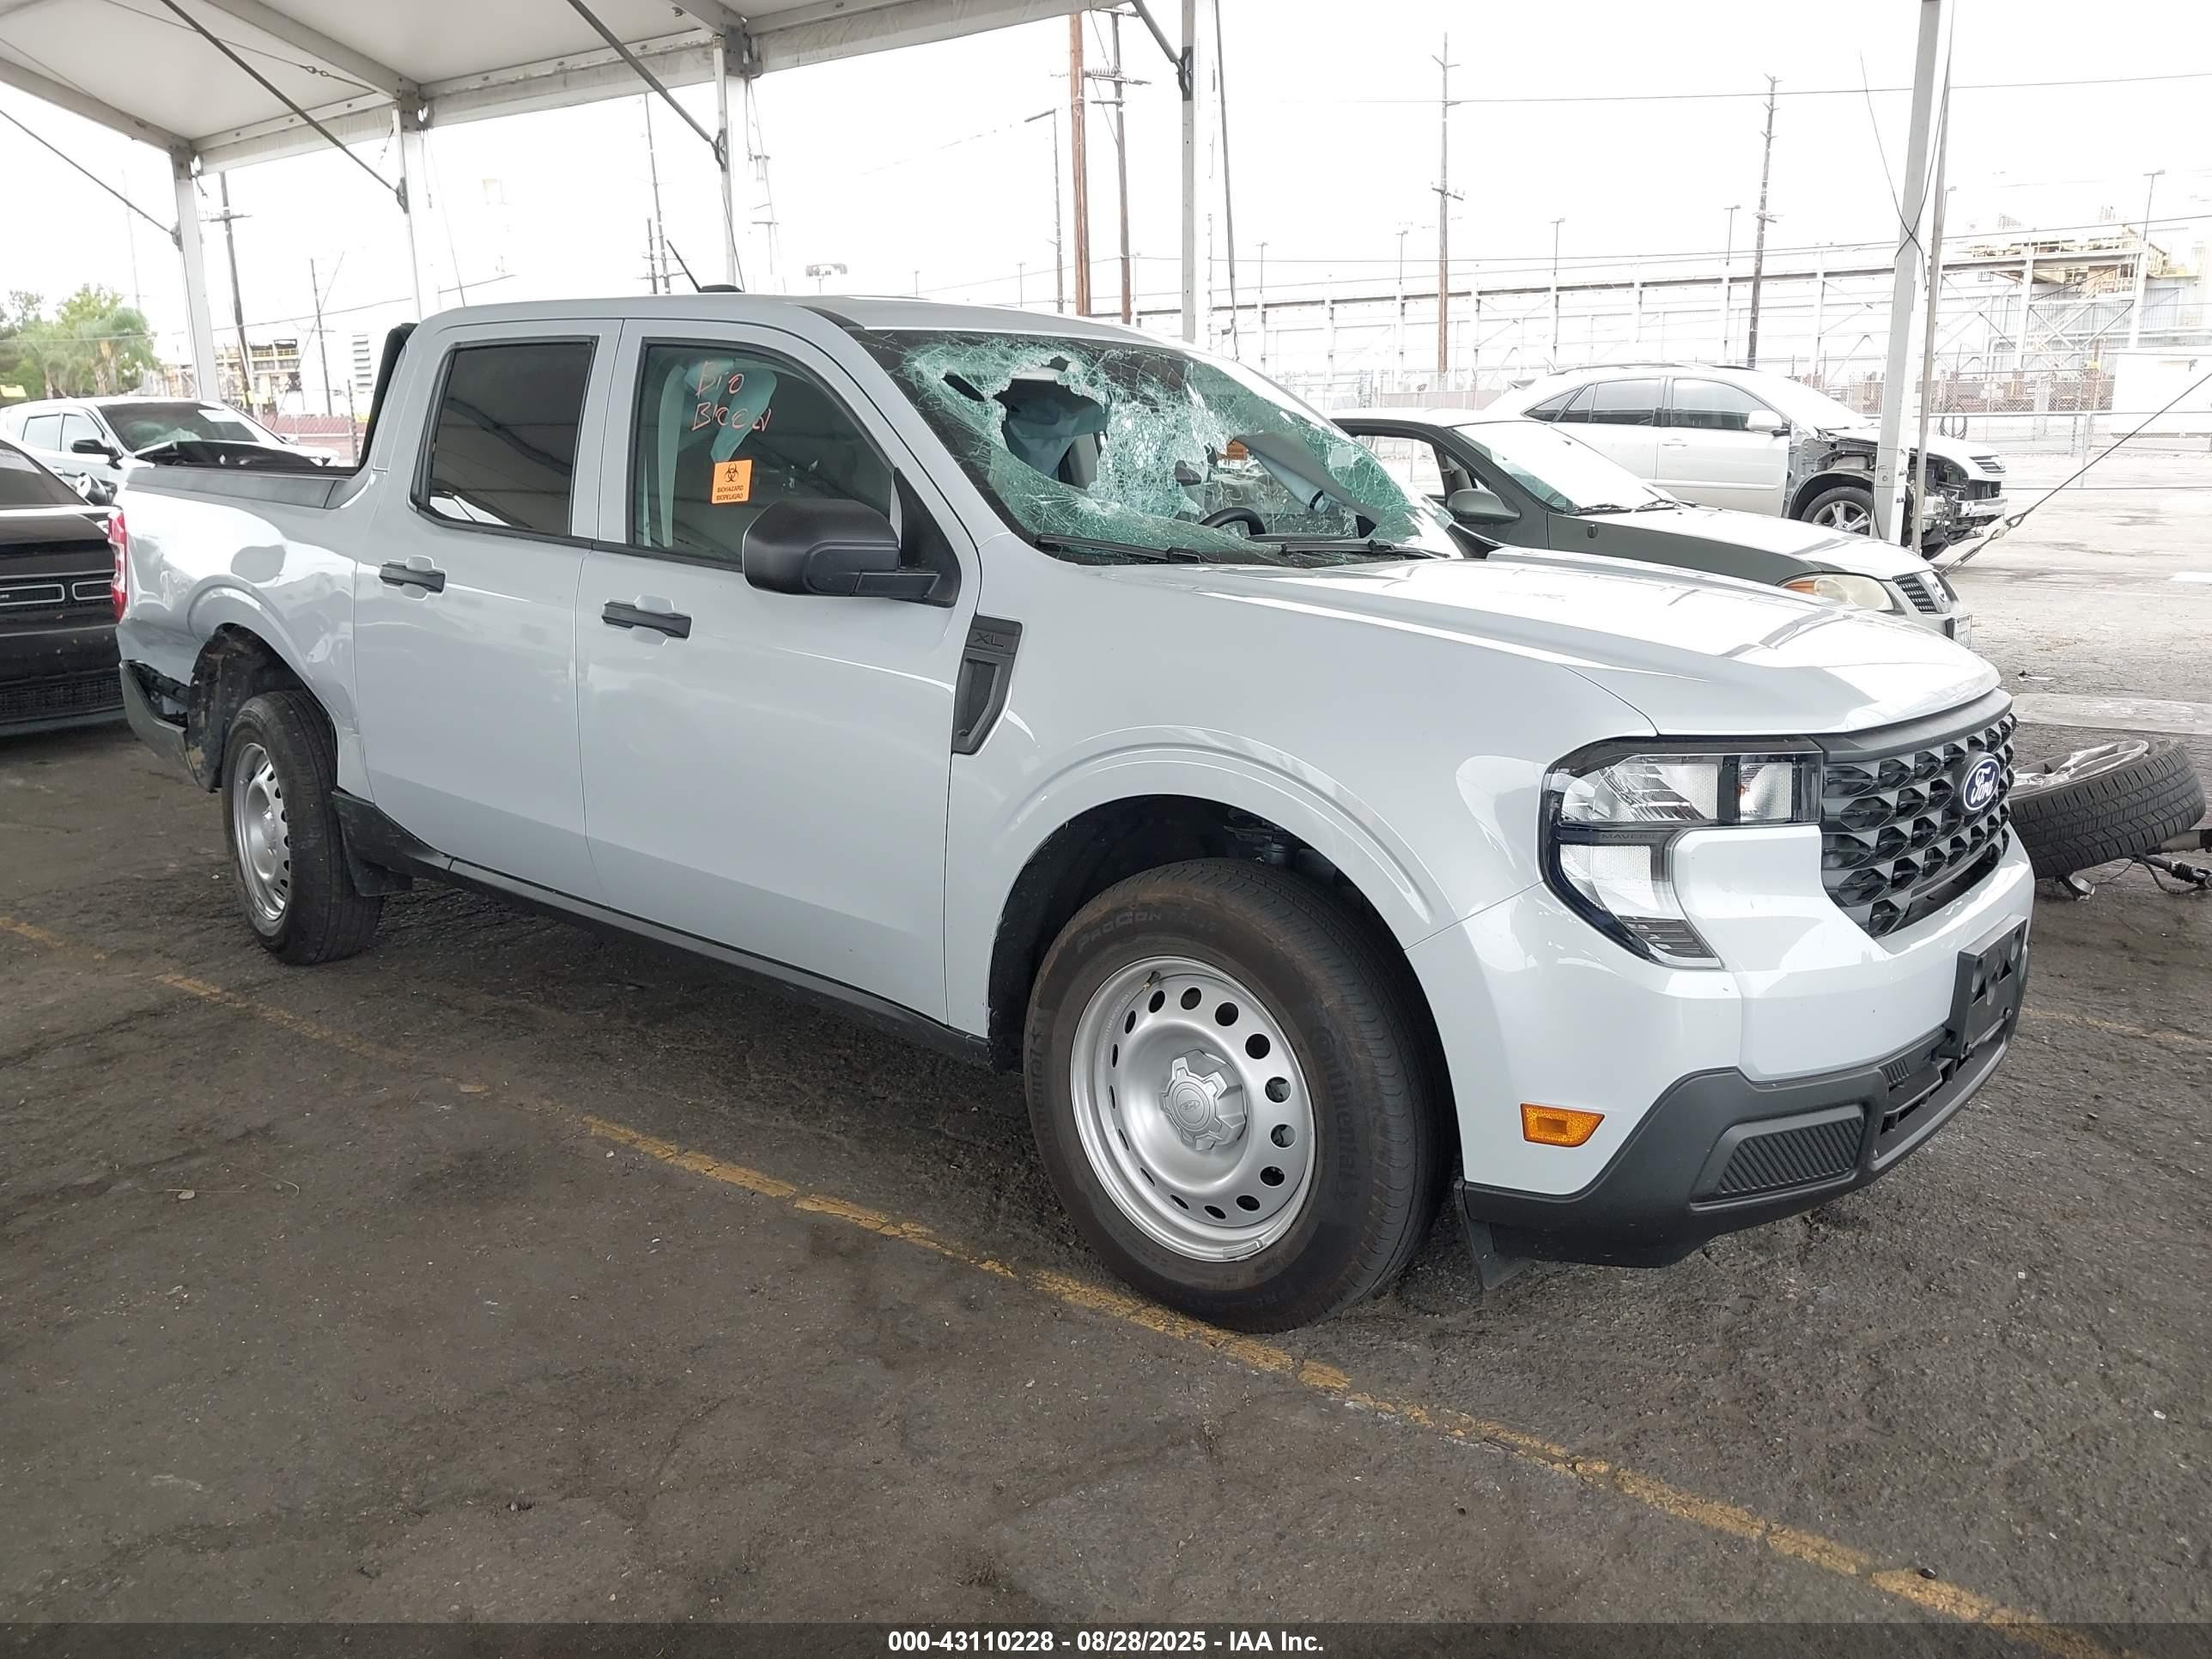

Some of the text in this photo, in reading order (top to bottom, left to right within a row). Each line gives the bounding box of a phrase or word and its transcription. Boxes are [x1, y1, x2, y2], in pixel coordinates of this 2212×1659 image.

[717, 484, 744, 493] BIOHAZARD
[975, 632, 1004, 647] XL
[1970, 766, 1996, 805] Ford
